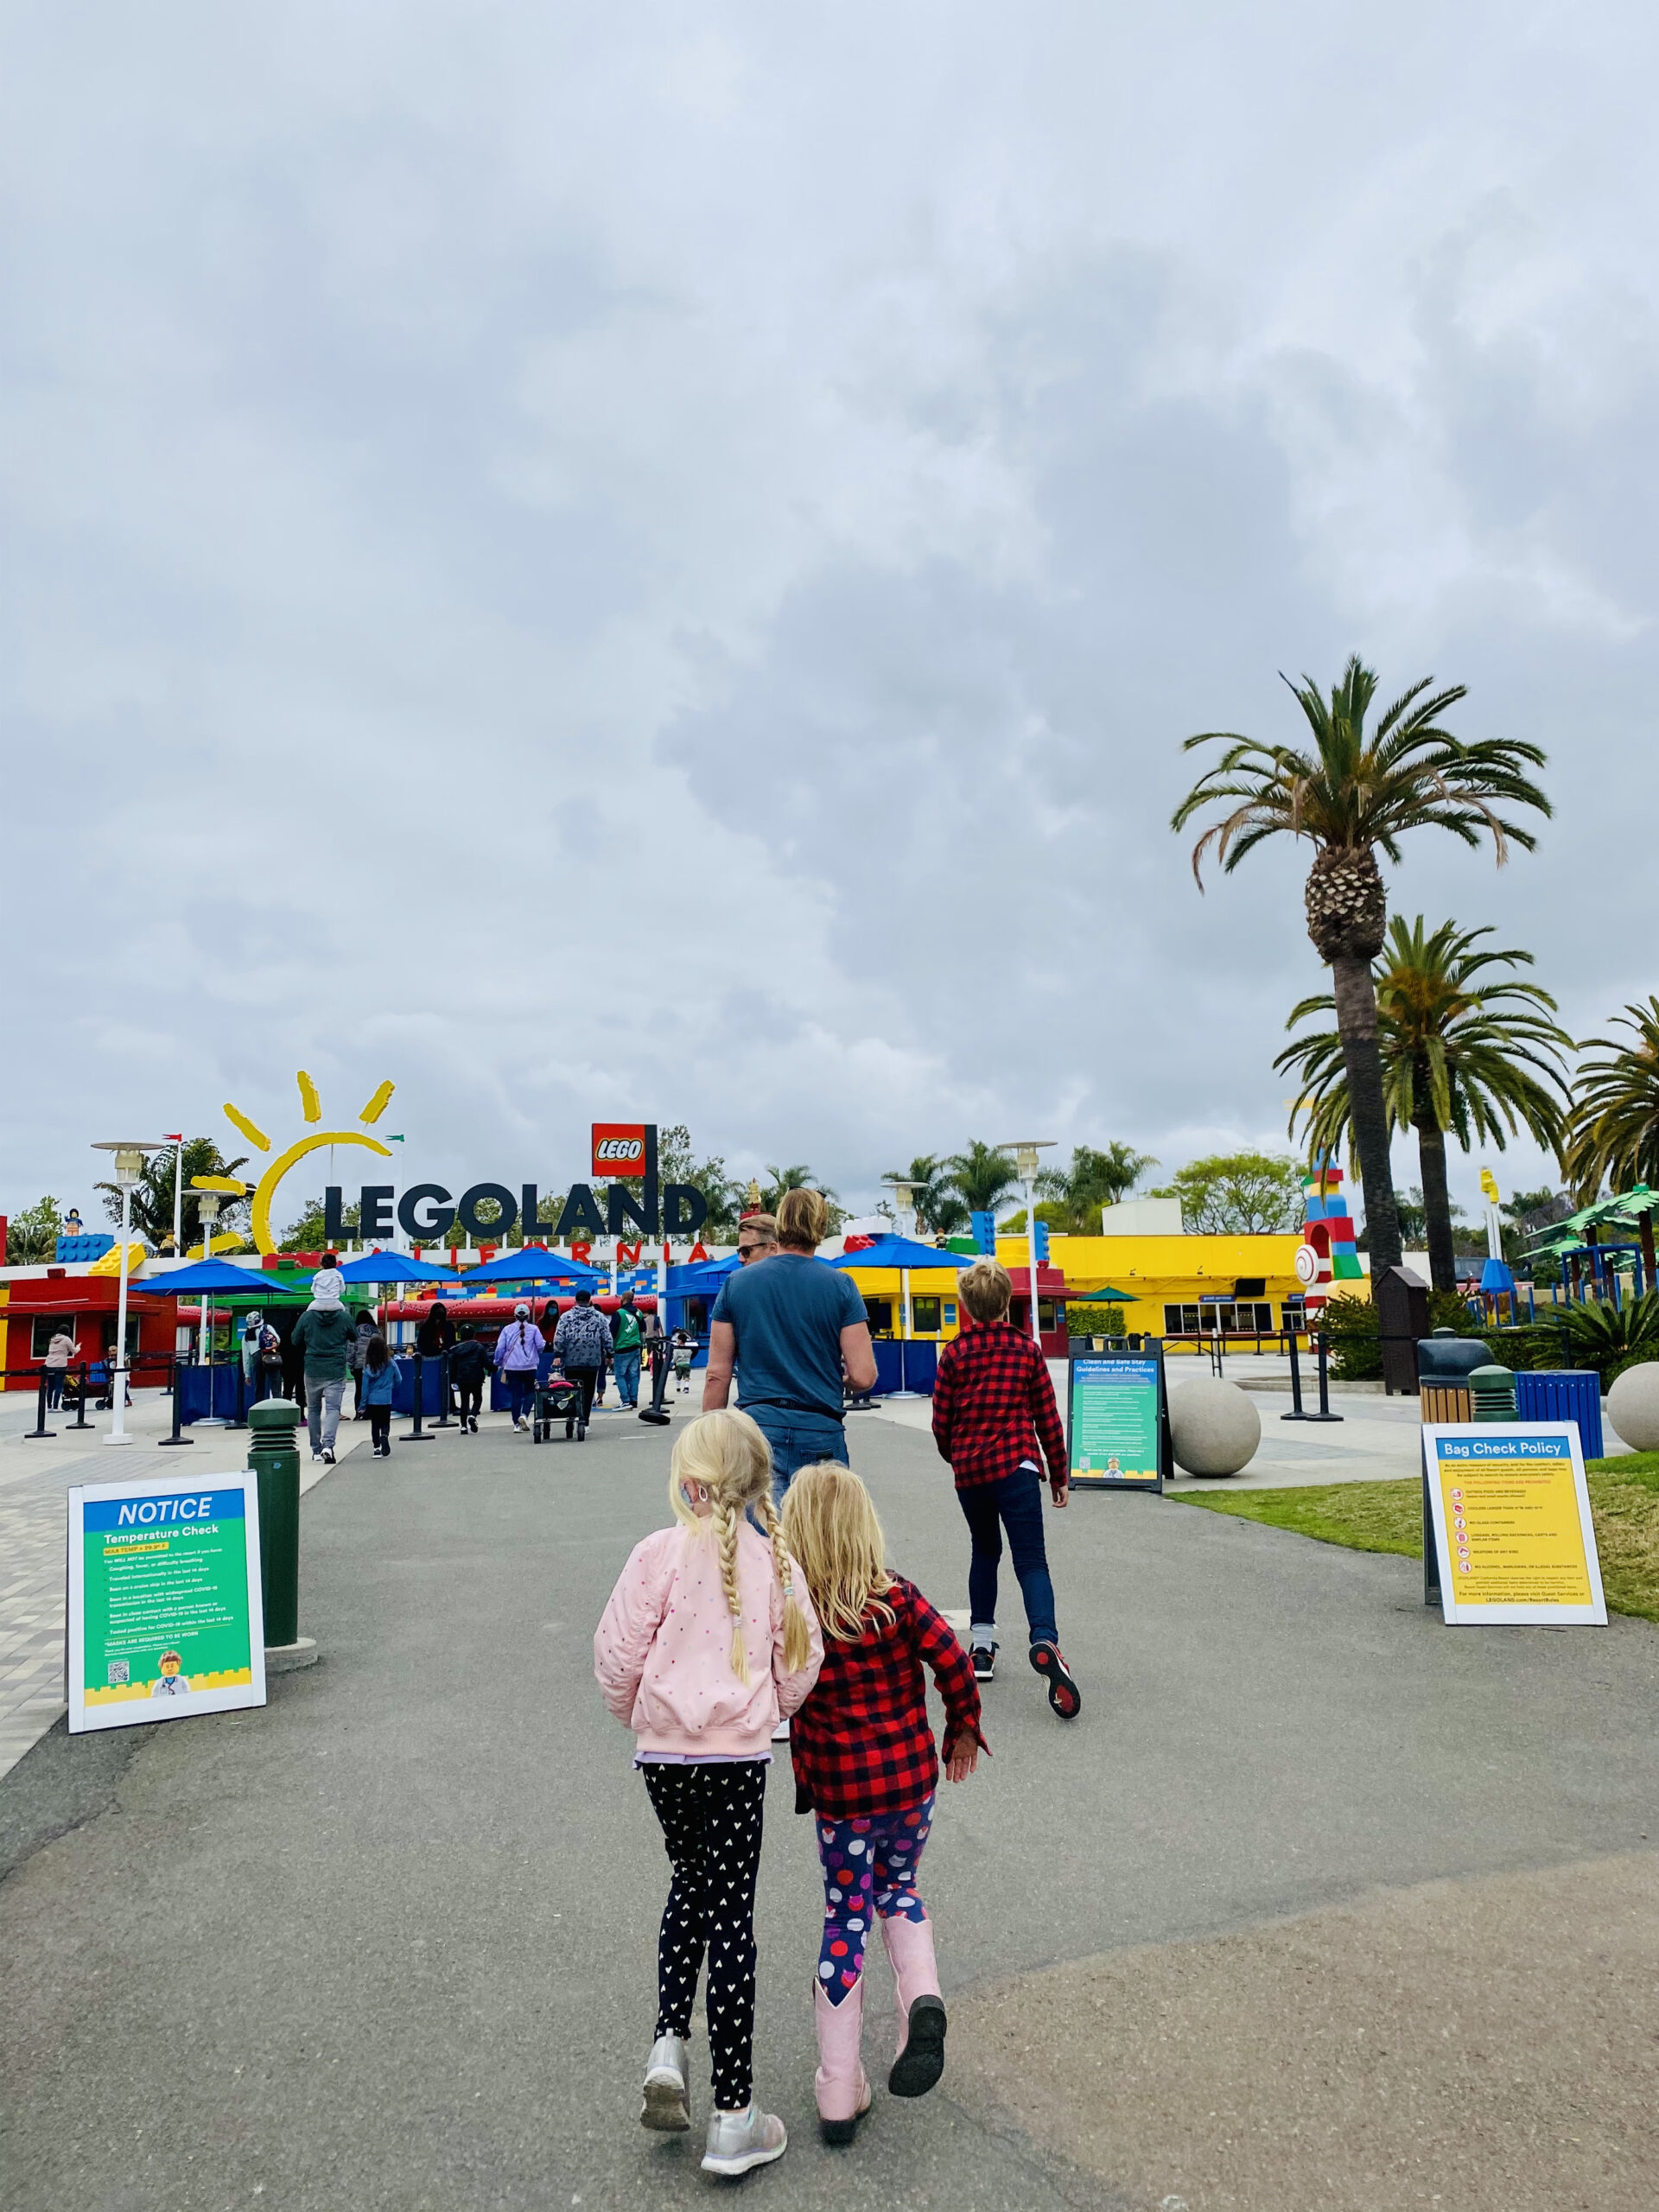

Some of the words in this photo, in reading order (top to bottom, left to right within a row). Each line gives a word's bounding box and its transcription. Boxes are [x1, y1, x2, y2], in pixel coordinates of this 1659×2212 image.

[596, 1138, 643, 1160] LEGO
[324, 1182, 708, 1240] LEGOLAND
[325, 1240, 708, 1267] IFRNIA
[1444, 1443, 1469, 1457] Bag
[1472, 1443, 1516, 1454] Check
[1521, 1442, 1560, 1456] Policy
[118, 1497, 213, 1525] NOTICE
[104, 1530, 179, 1544] Temperature
[181, 1524, 219, 1536] Check
